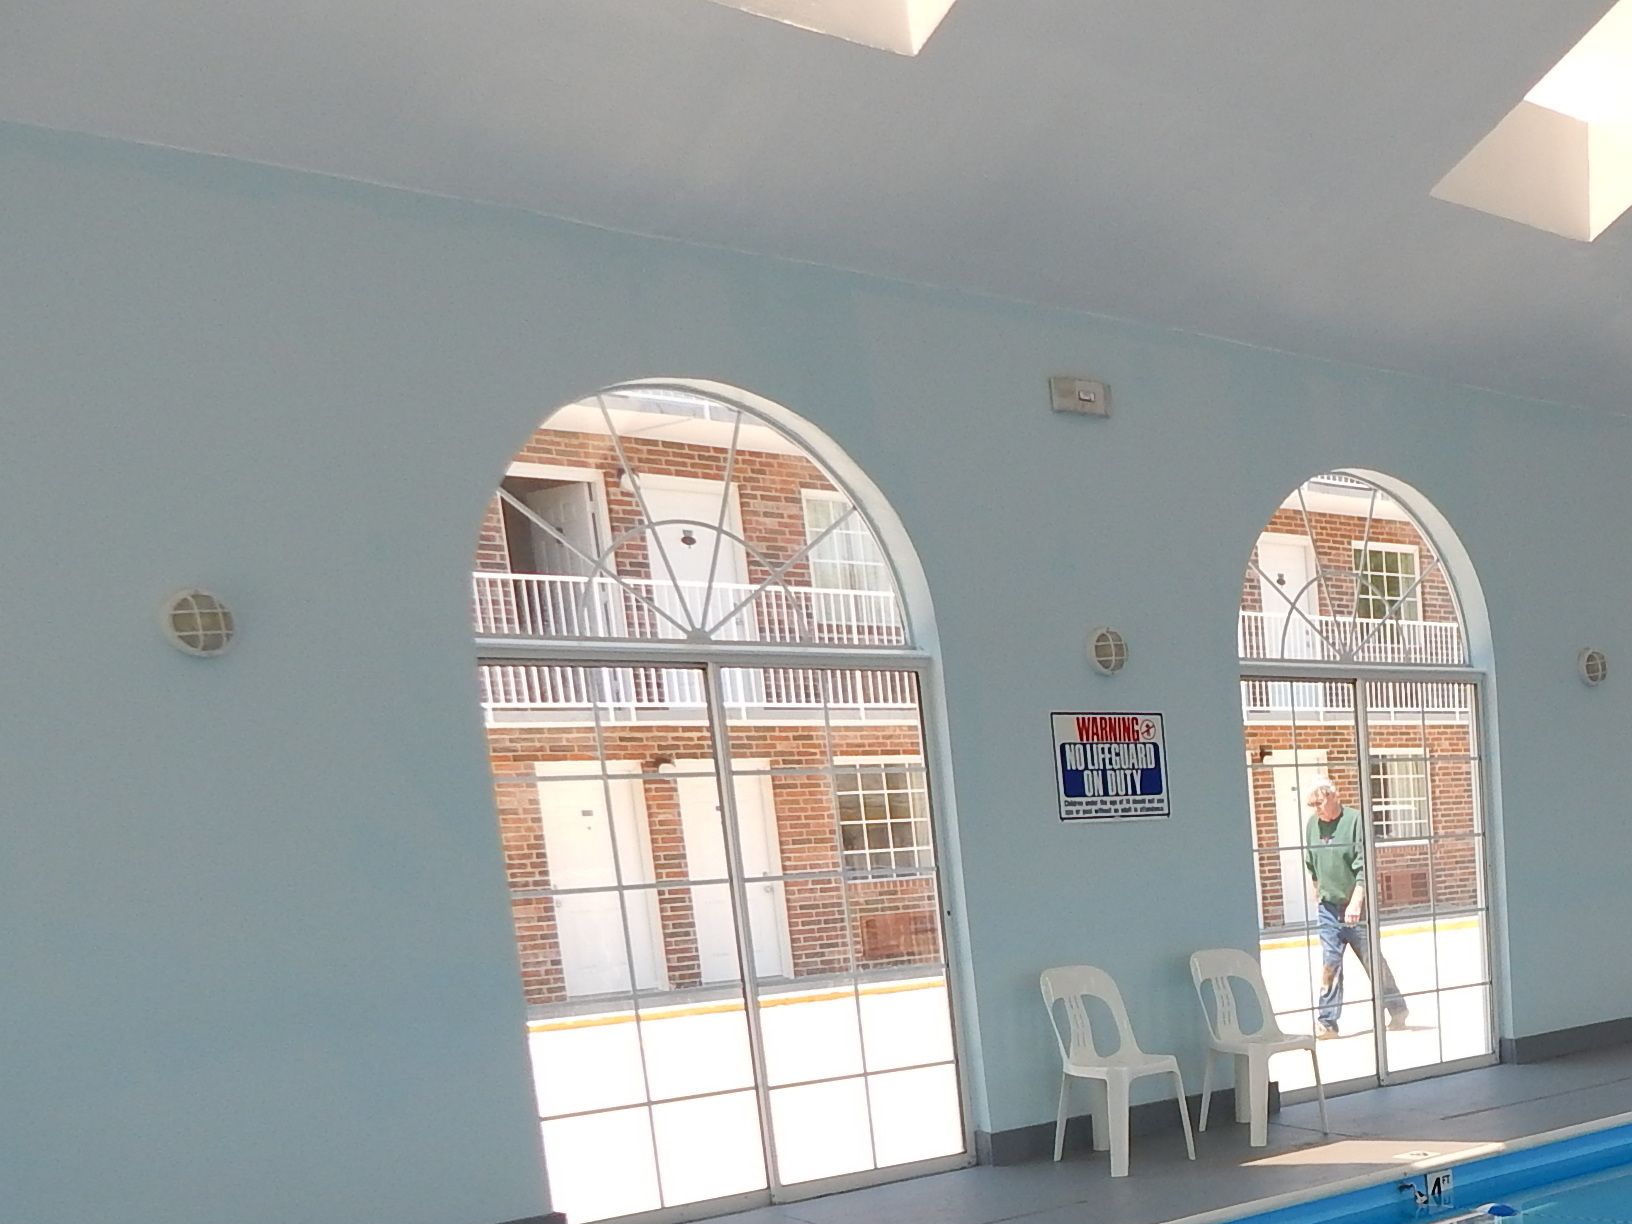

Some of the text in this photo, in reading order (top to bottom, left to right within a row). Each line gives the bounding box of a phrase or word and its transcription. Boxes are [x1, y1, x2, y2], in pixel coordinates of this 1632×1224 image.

[1076, 716, 1140, 742] WARNING
[1065, 743, 1155, 770] NO LIFEGUARD
[1083, 769, 1141, 796] ON DUTY
